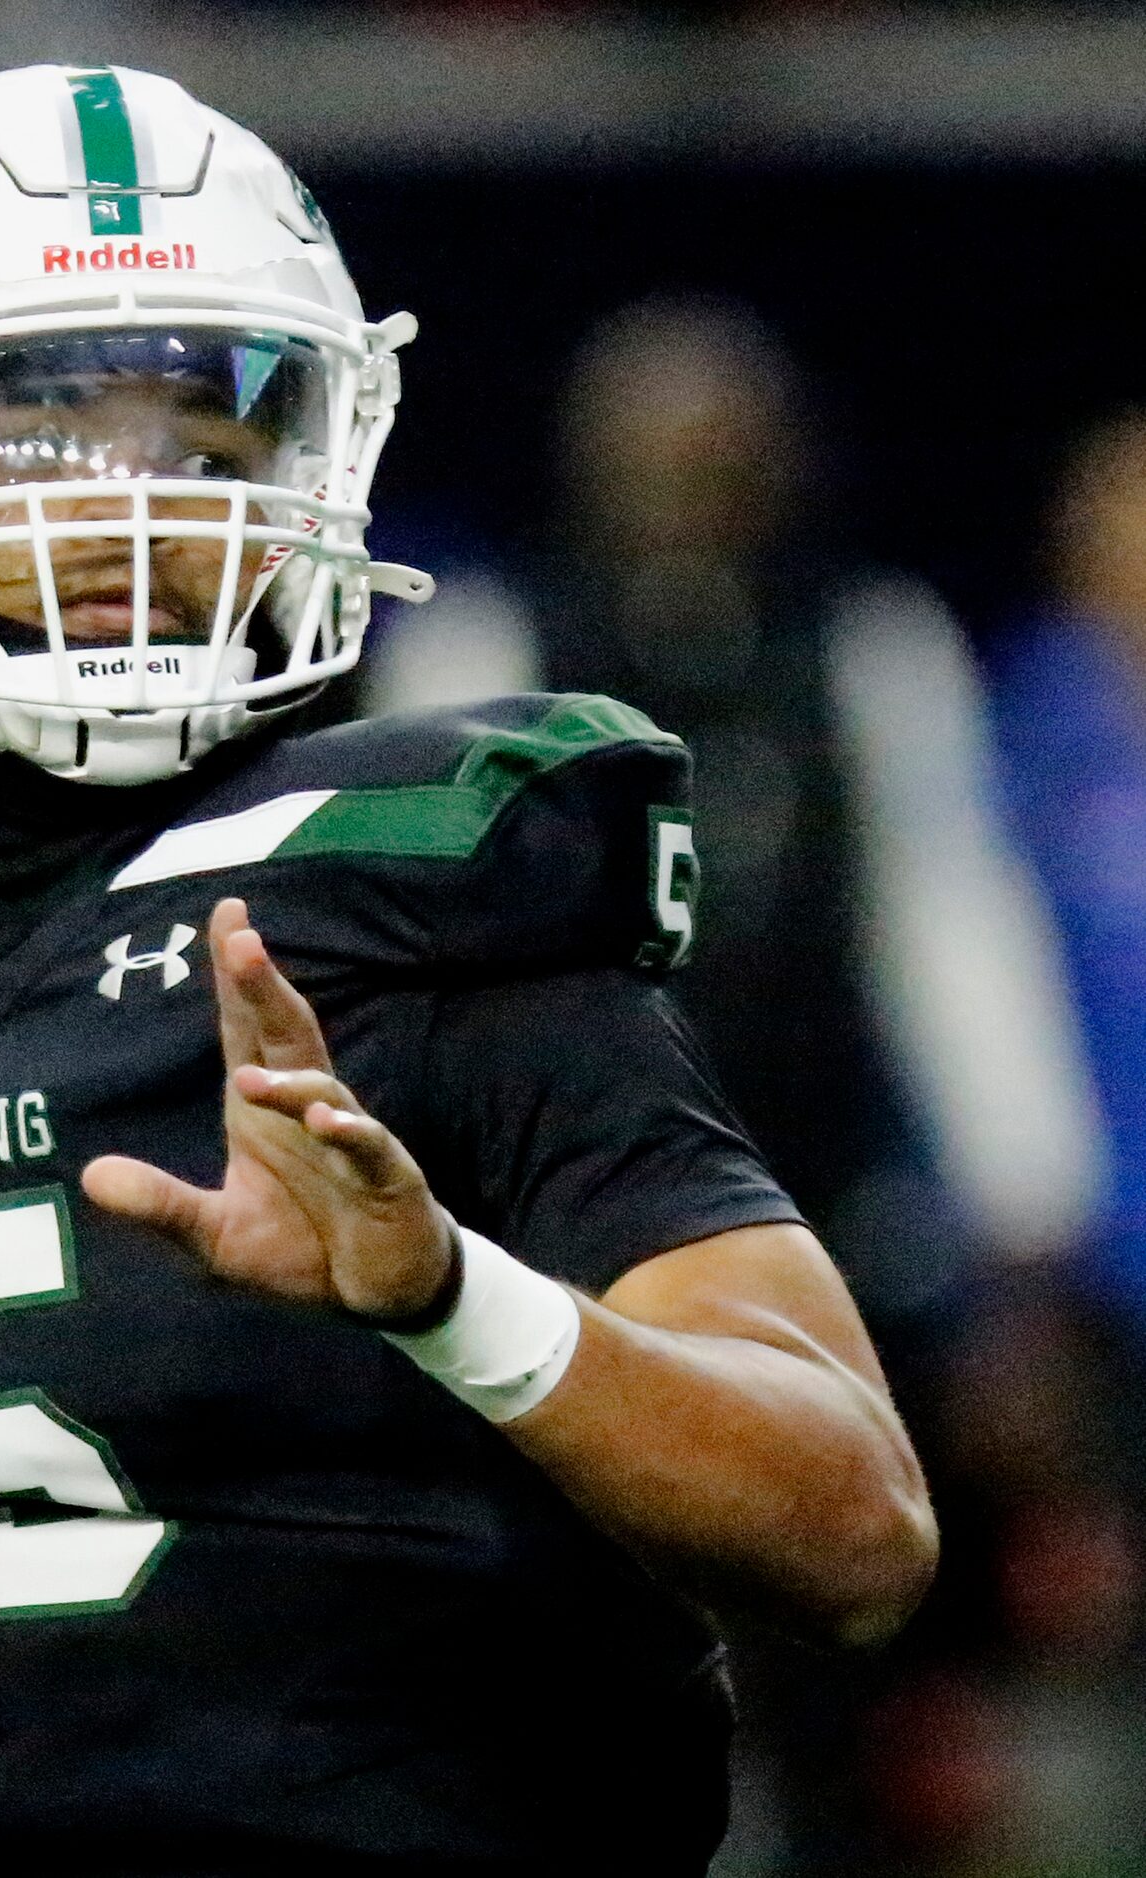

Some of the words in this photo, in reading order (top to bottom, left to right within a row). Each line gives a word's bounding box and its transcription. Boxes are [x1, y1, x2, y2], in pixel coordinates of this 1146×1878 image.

[42, 242, 197, 274] Riddell
[77, 657, 181, 678] Ridell
[647, 806, 702, 970] 5
